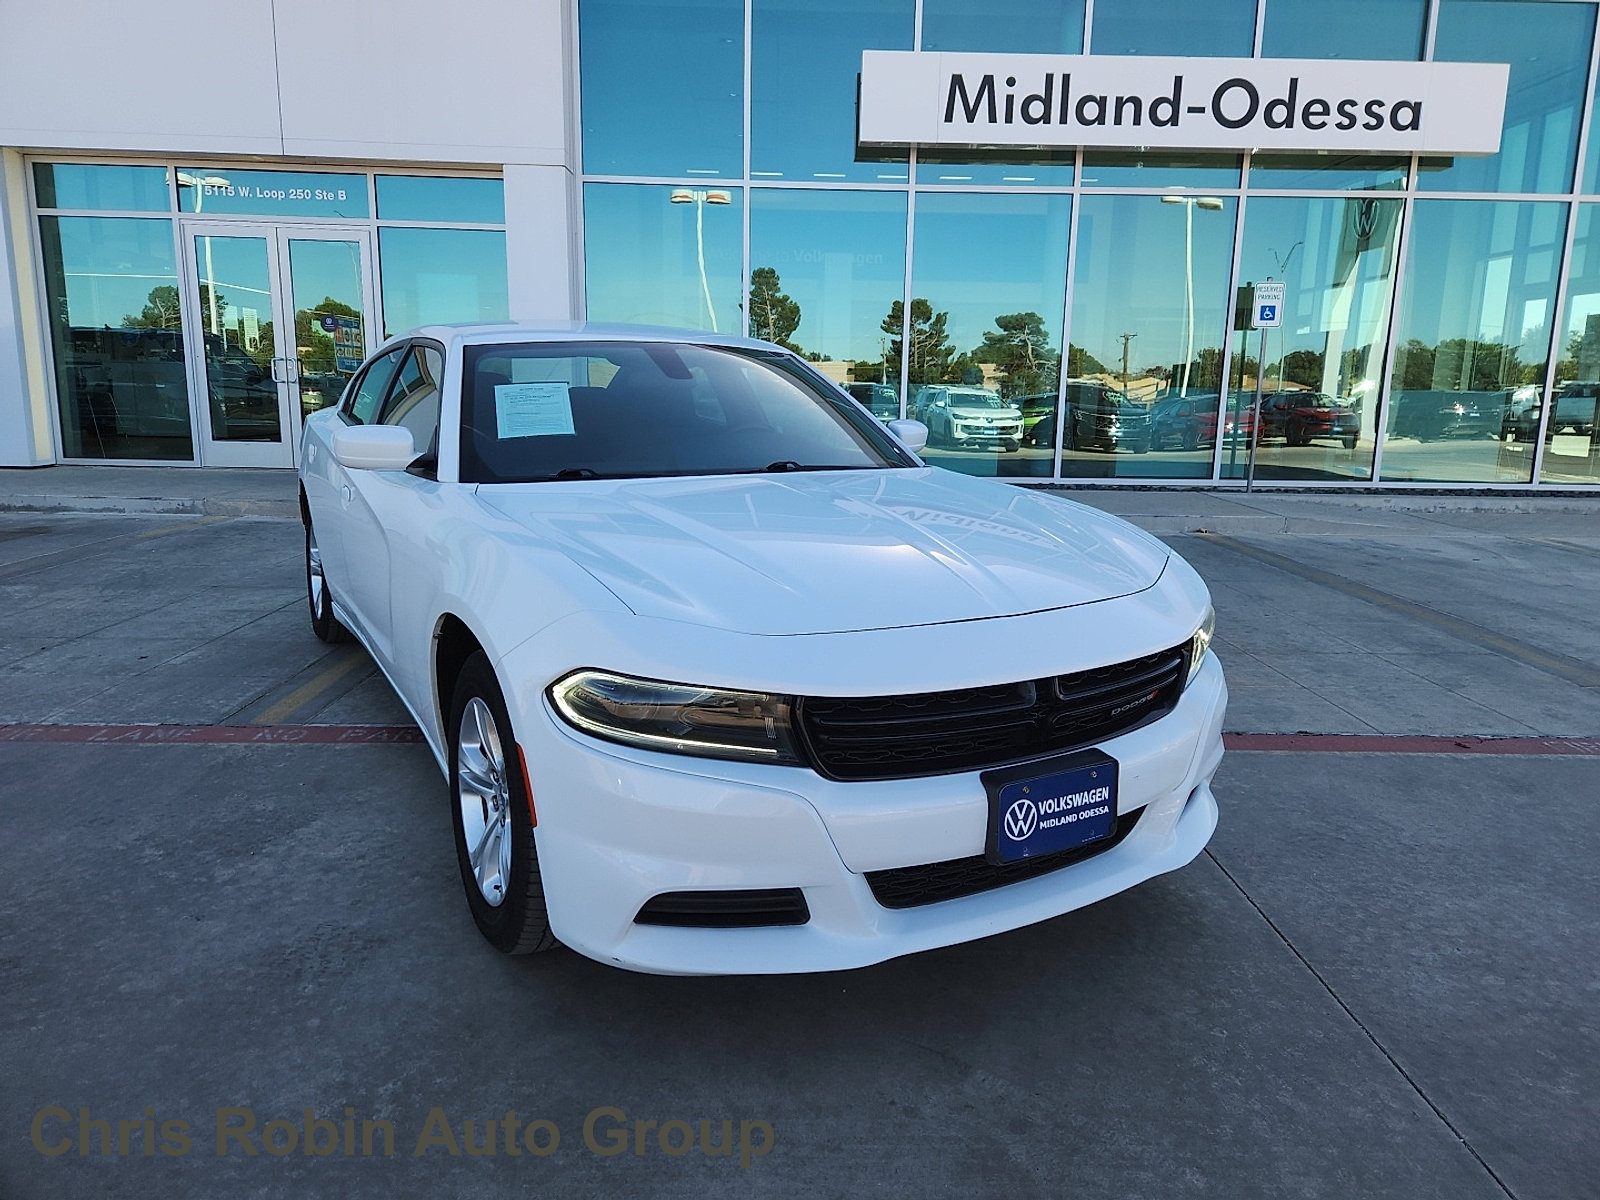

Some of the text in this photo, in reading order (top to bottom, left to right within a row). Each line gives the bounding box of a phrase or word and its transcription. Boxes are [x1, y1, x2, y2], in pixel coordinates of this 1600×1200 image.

[943, 73, 1422, 131] Midland-Odessa
[204, 185, 347, 201] 5115 W. Loop 250 Ste B
[793, 250, 884, 267] Volkgen
[1111, 692, 1154, 716] DODGE
[336, 728, 424, 742] PAR
[1037, 786, 1109, 815] VOLKSWAGEN
[1039, 805, 1109, 830] MIDLAND ODESSA
